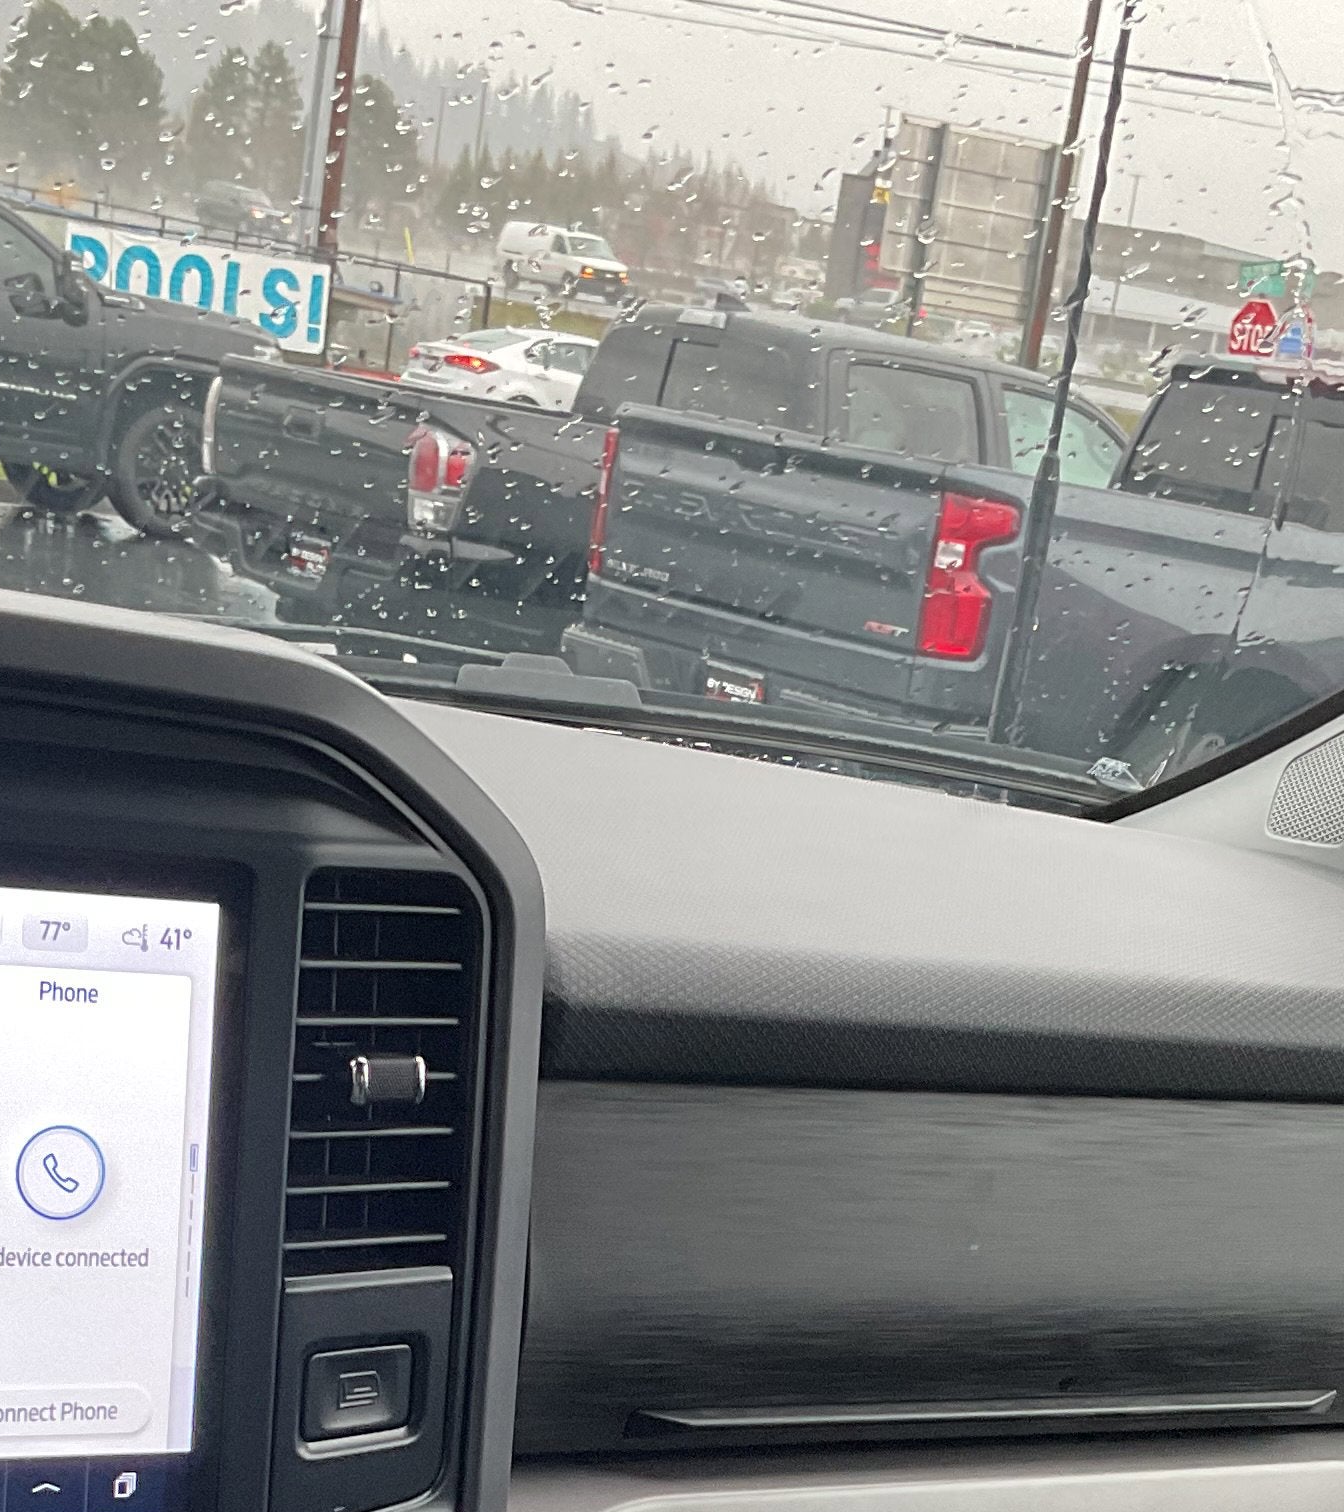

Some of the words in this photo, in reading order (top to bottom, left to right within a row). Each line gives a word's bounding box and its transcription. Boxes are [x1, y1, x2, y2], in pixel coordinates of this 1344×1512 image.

[39, 919, 72, 942] 77°
[160, 927, 193, 951] 41°
[39, 981, 99, 1004] Phone
[55, 1247, 150, 1268] connected
[60, 1401, 119, 1422] Phone
